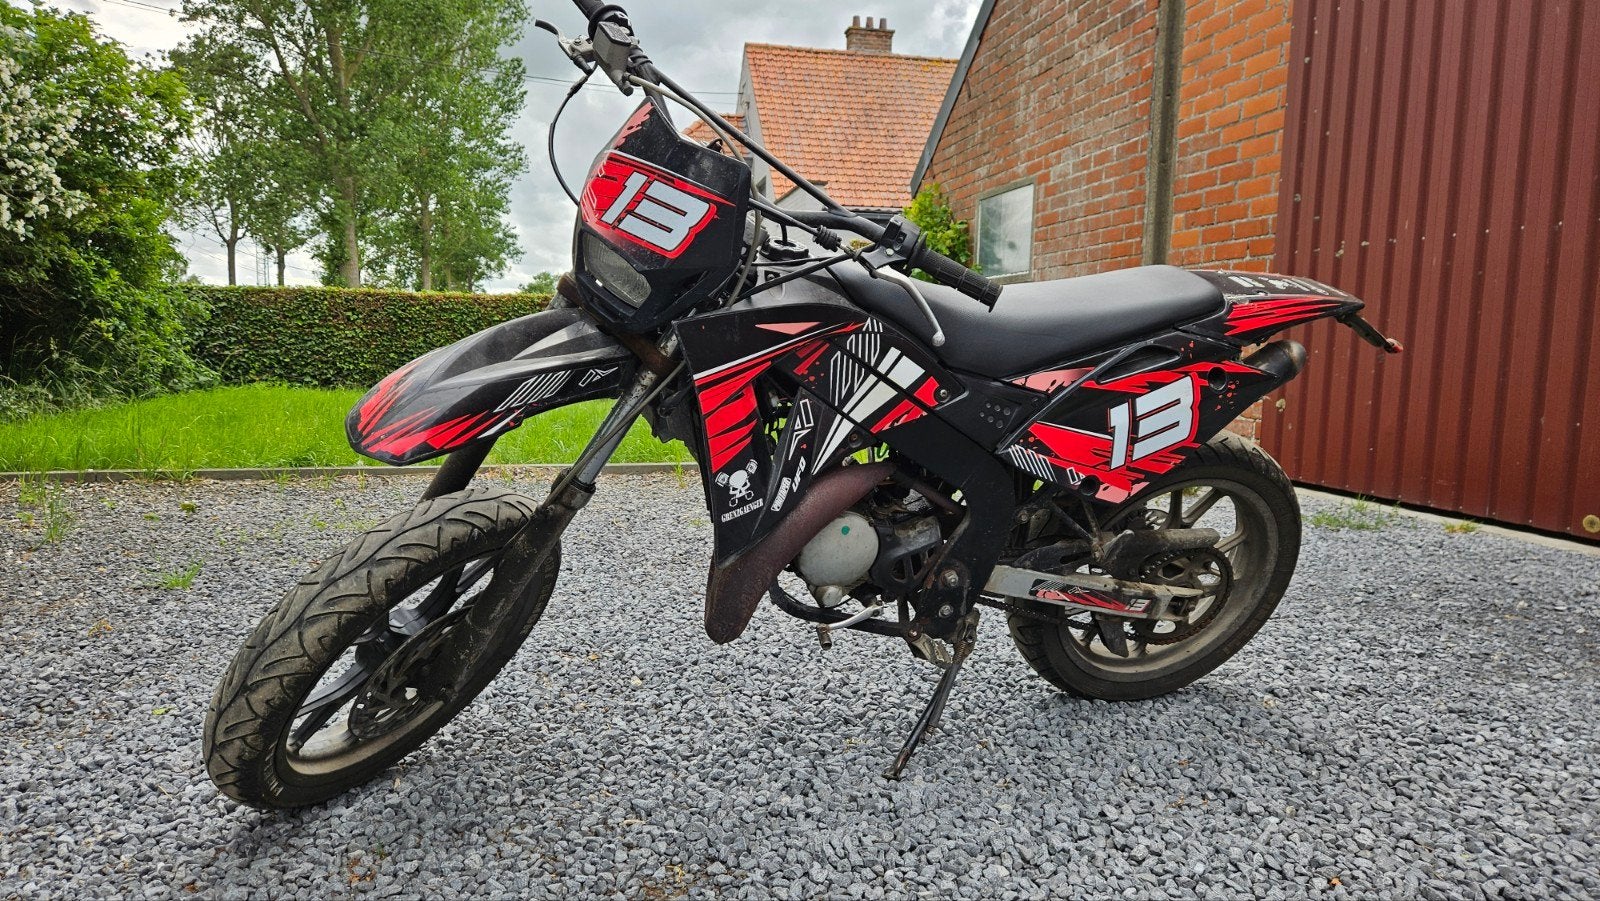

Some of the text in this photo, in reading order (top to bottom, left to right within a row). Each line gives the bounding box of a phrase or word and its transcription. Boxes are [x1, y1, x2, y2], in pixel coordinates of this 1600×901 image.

[600, 170, 710, 251] 13
[1109, 375, 1194, 470] 13
[792, 455, 807, 493] UFO
